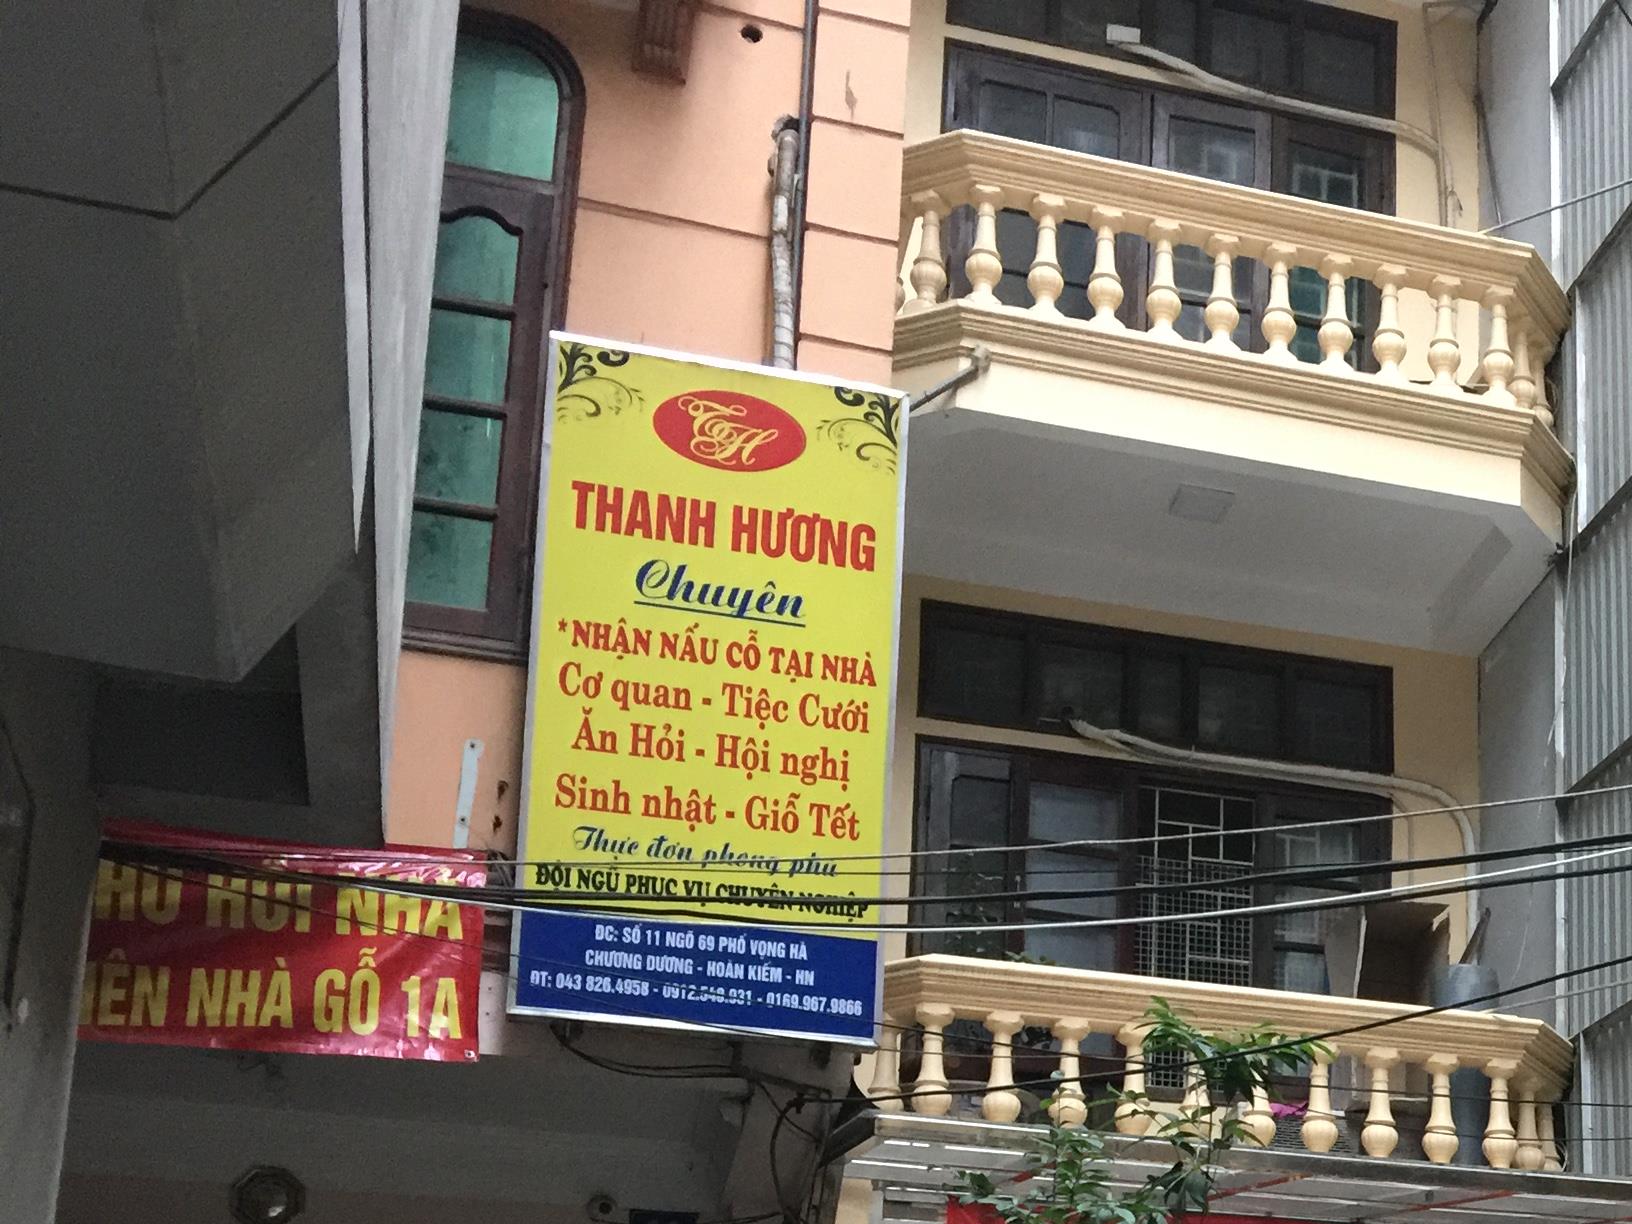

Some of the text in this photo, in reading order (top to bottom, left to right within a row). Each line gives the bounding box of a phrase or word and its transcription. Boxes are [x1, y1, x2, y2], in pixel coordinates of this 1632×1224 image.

[571, 480, 877, 572] THANH HƯƠNG
[634, 558, 807, 619] Chuyên
[571, 617, 877, 687] NHẬN NẤU CỖ TẠI NHÀ
[558, 661, 869, 734] Cơ quan Tiệc Cưới
[571, 706, 850, 792] Ăn Hỏi Hội nghị
[555, 772, 861, 842] Sinh nhật Giỗ Tết
[572, 825, 640, 861] Thực
[646, 835, 694, 861] đơn
[700, 842, 781, 876] phong
[585, 949, 815, 987] CHƯƠNG DƯƠNG HOÀN KIẾM HN
[595, 922, 809, 961] ĐC: SỐ 11 NGÕ 69 PHỐ VỌNG HÀ
[186, 957, 294, 1028] NHÀ
[313, 946, 381, 1036] GỖ
[401, 975, 462, 1040] 1A
[530, 970, 552, 988] ĐT:
[555, 972, 582, 991] 043
